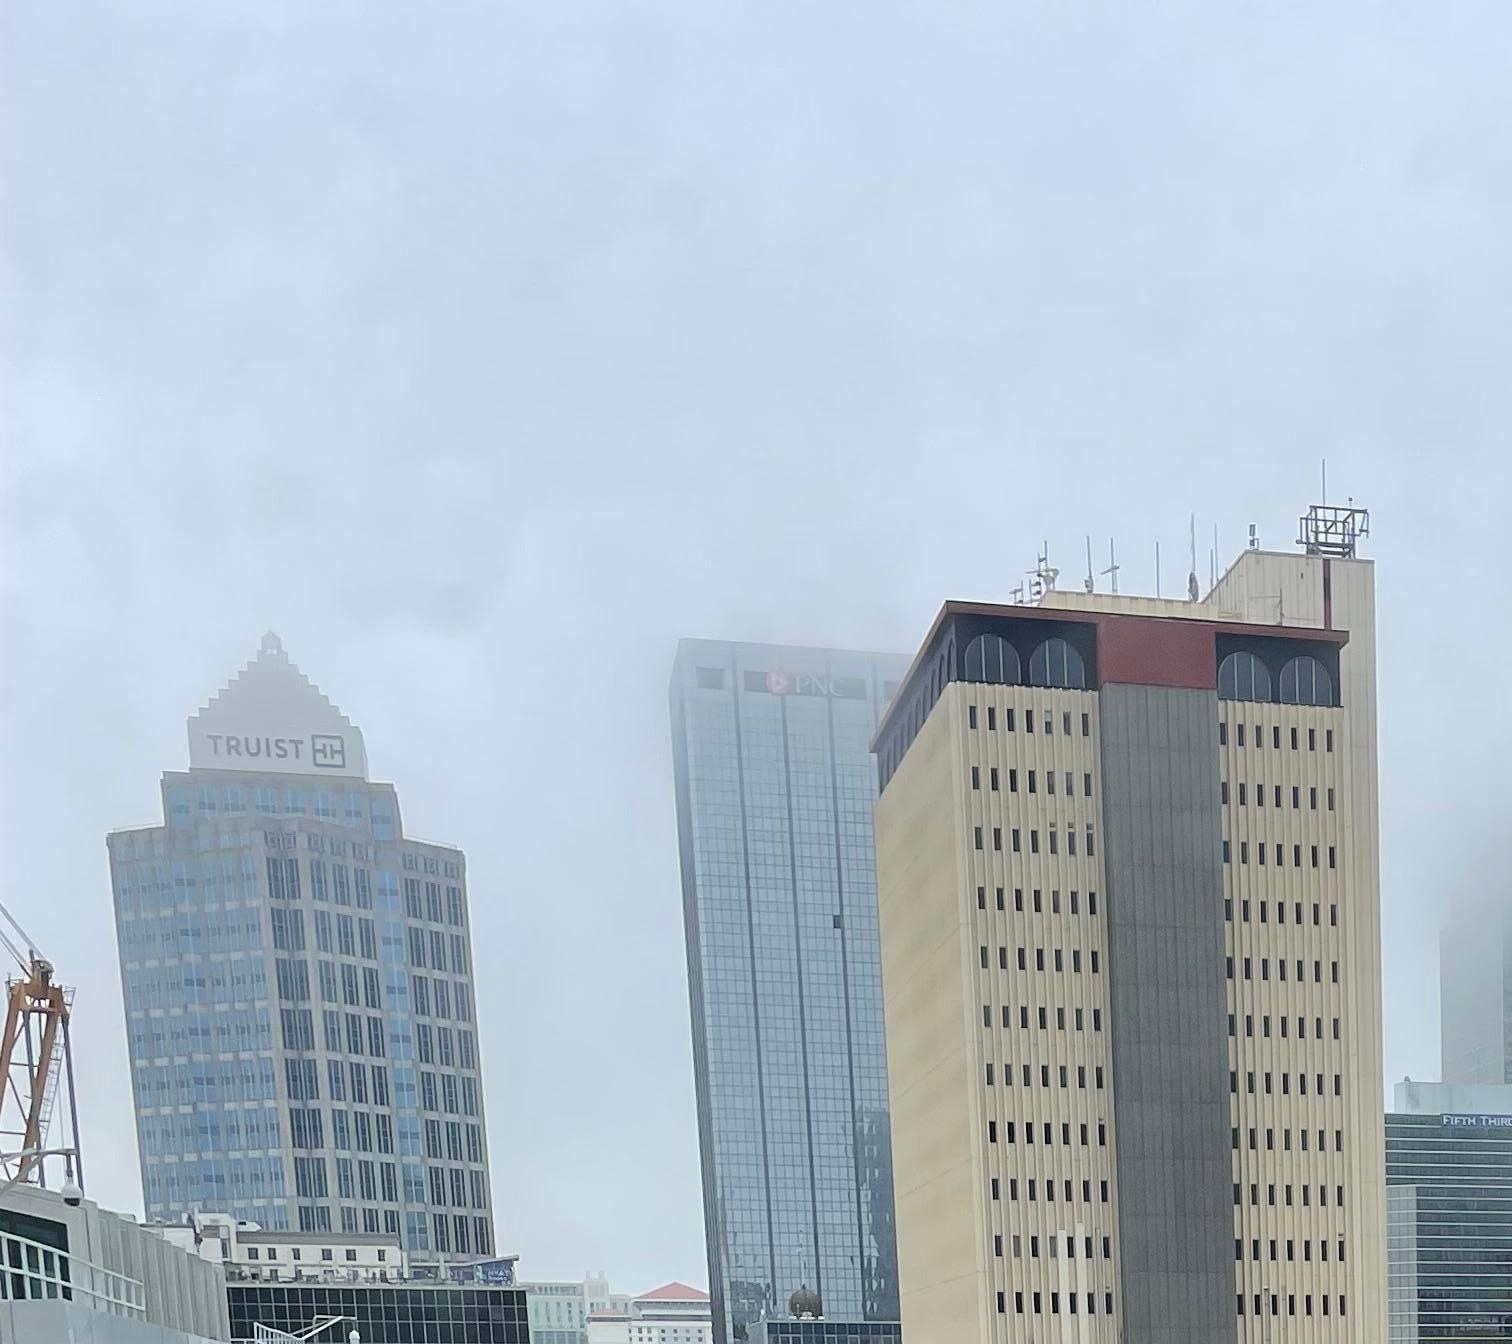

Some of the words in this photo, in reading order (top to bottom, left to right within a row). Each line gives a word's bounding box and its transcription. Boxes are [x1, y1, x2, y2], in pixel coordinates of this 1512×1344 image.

[795, 673, 846, 697] PNC
[207, 735, 304, 760] TRUIST
[1443, 1115, 1476, 1126] FIFTH
